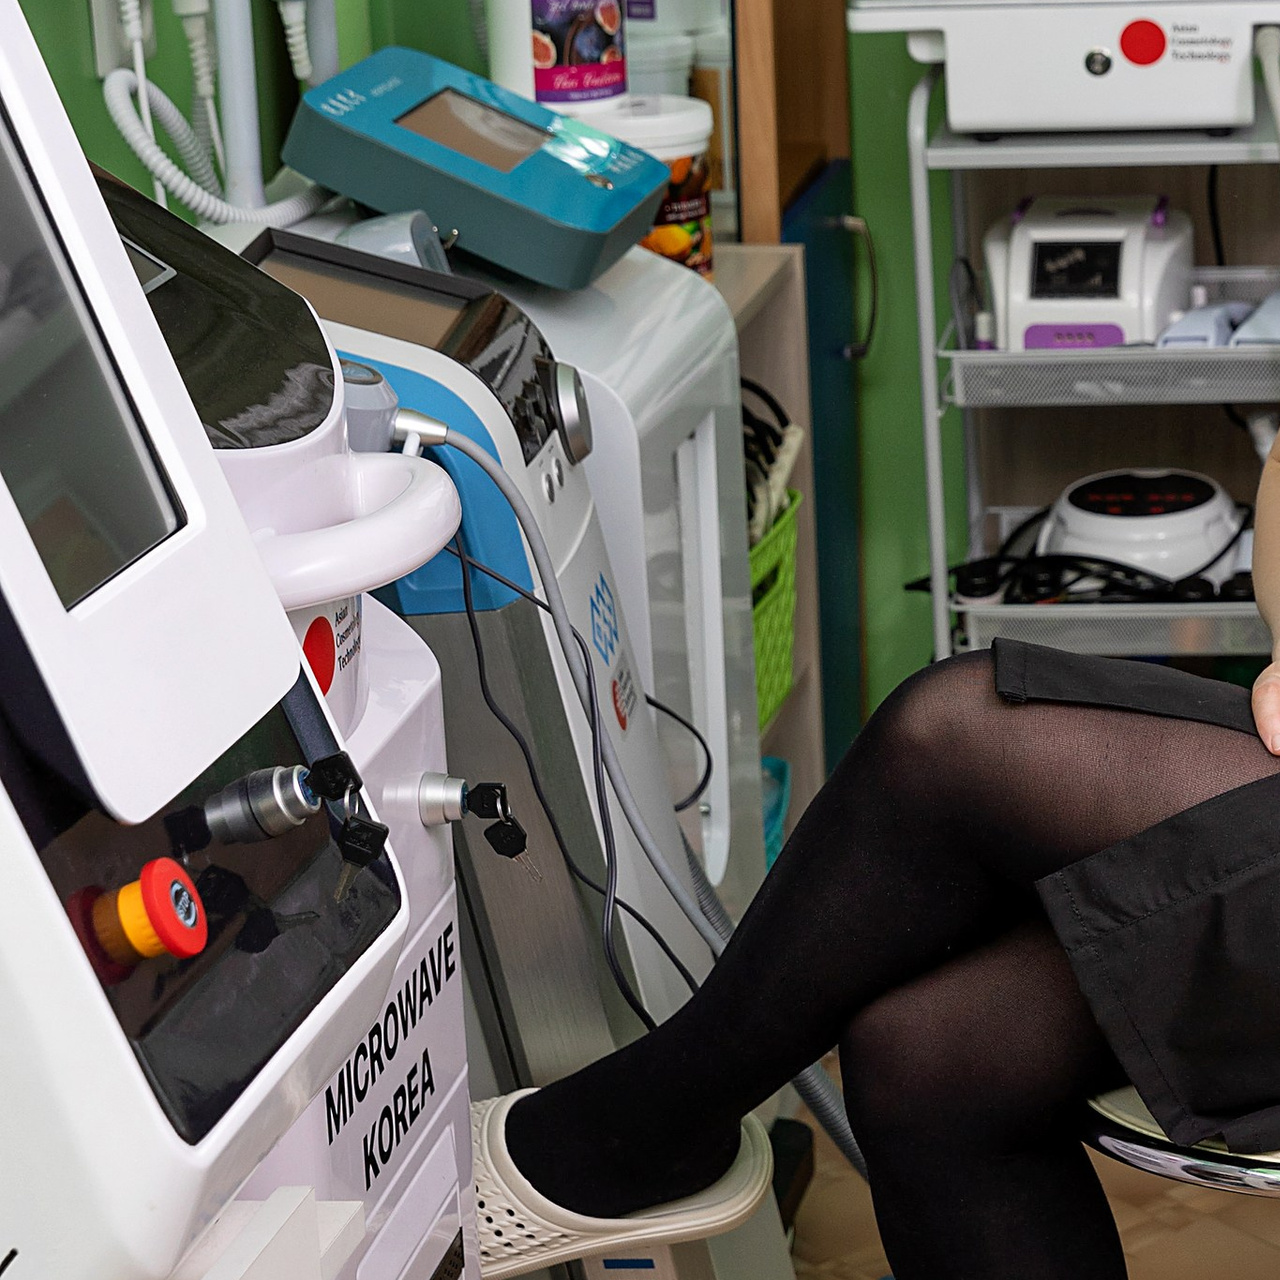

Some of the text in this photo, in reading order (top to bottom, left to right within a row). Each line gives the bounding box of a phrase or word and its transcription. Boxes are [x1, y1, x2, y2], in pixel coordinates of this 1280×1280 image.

[335, 606, 348, 627] Asian
[324, 921, 456, 1146] MICROWAVE
[362, 1047, 435, 1192] KOREA
